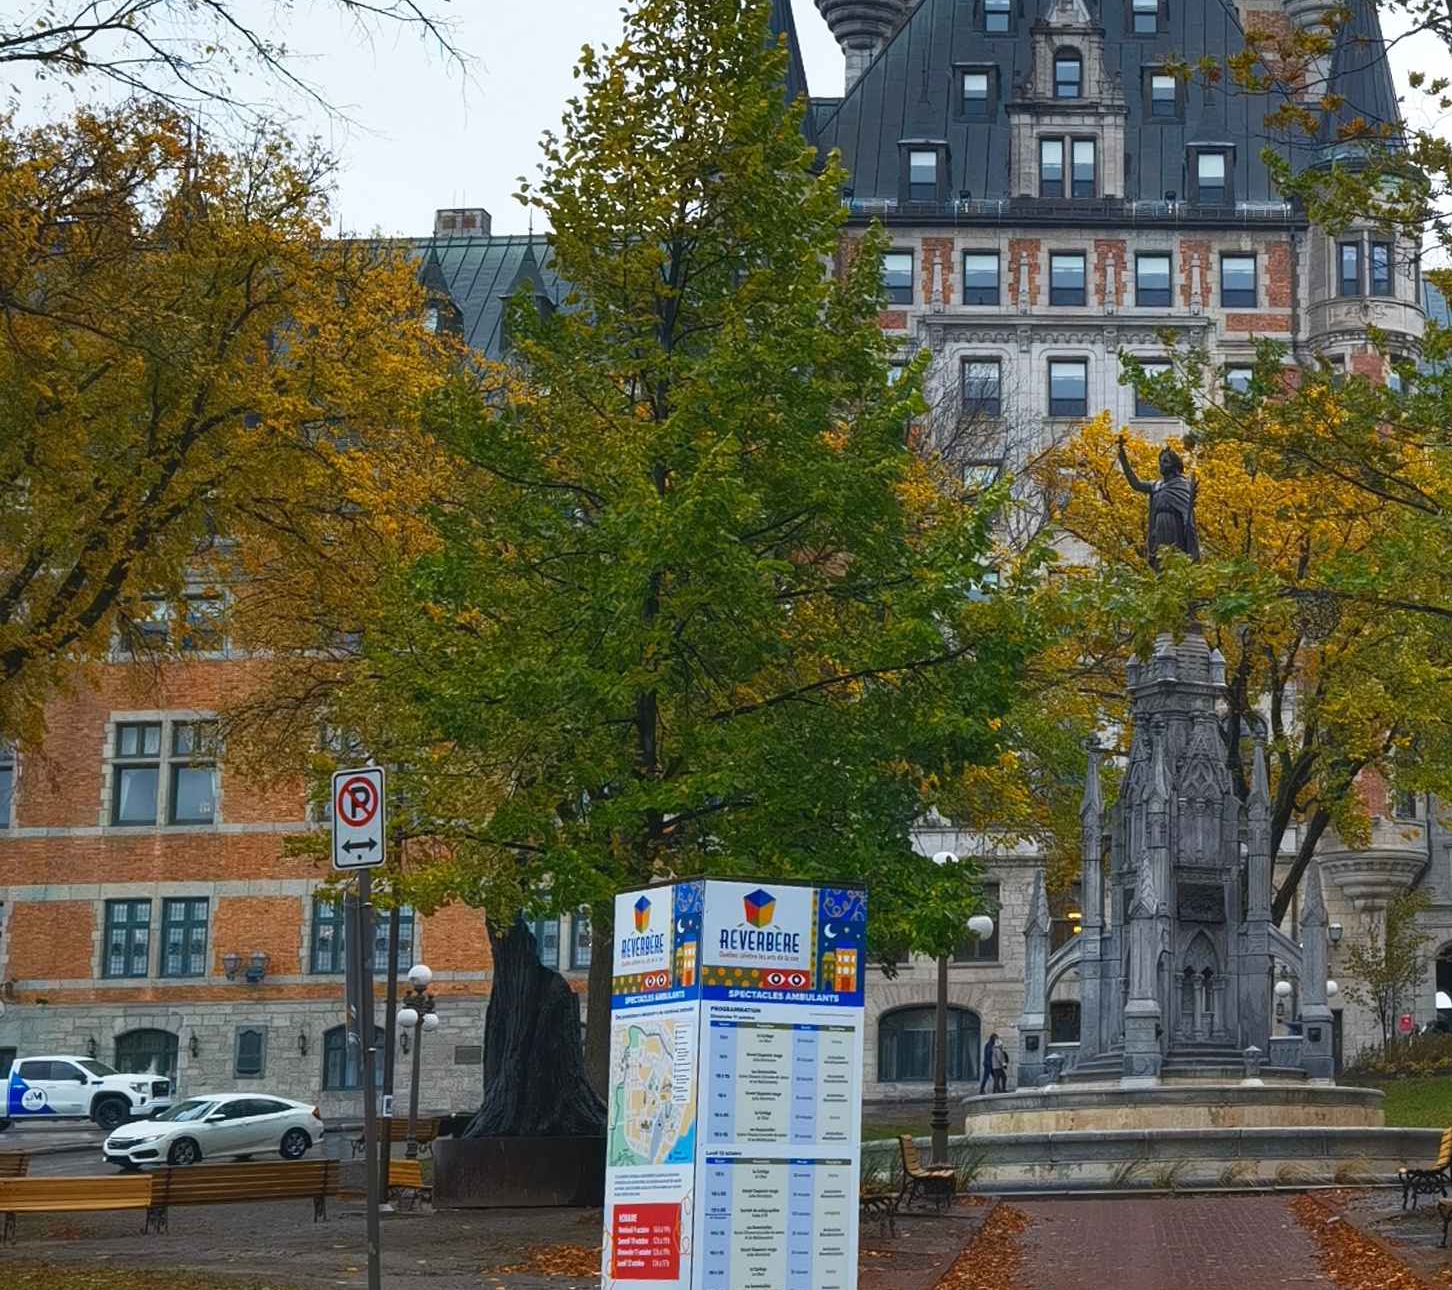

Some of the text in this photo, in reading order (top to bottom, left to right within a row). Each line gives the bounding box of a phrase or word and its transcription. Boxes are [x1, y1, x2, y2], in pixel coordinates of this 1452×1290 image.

[350, 786, 371, 818] P
[728, 990, 840, 1003] SPECTACLES AMBULANTS
